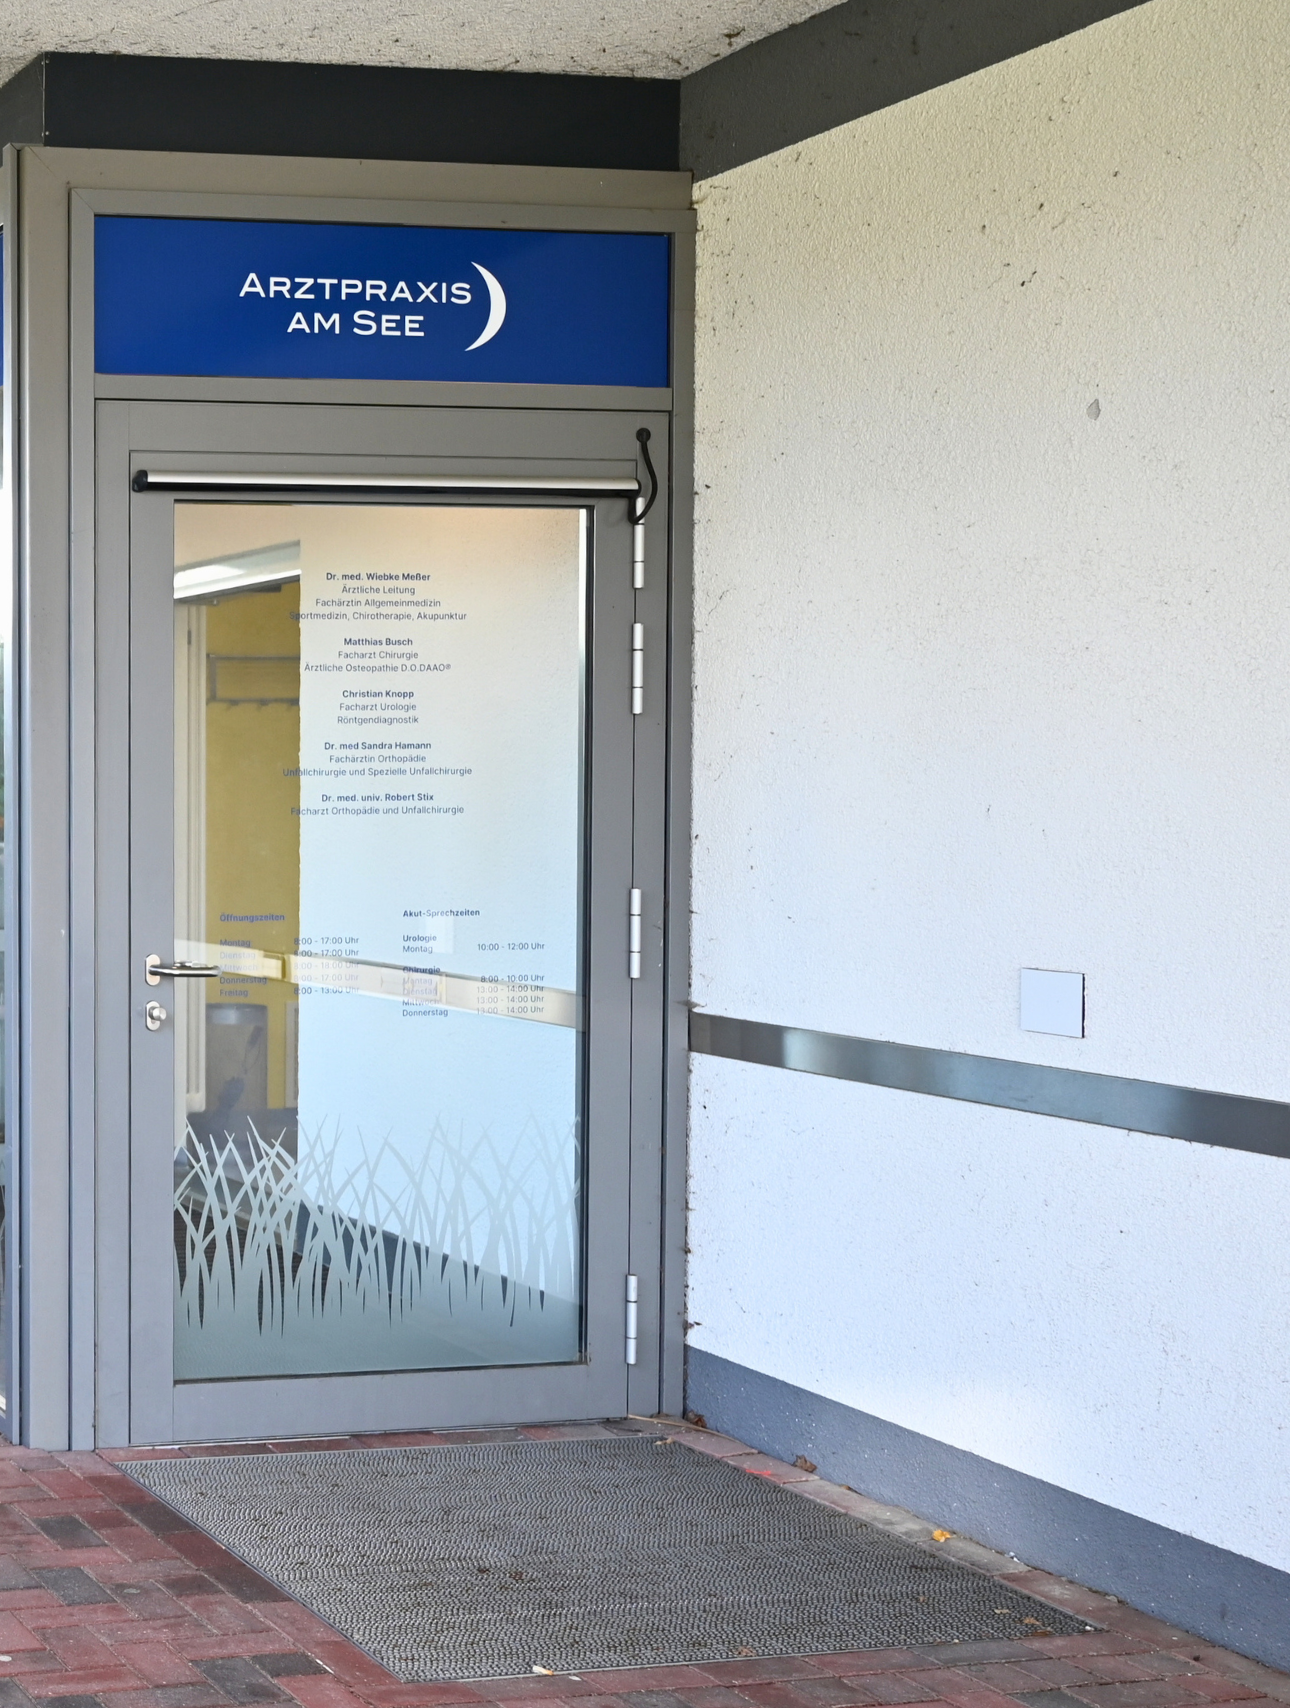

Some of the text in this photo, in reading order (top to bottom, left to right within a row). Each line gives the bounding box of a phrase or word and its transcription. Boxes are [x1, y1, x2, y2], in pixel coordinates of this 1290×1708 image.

[239, 272, 472, 305] ARZTPRAXIS
[287, 310, 424, 337] AM SEE
[326, 572, 430, 581] Dr. med. Wiebke Meßer
[342, 584, 415, 596] Ärztliche Leitung
[315, 598, 441, 609] Fachärztin Allgemeinmedizin
[289, 611, 467, 621] Sportmedizin, Chirotherapie, Akupunktur
[344, 637, 413, 646] Matthias Busch
[338, 650, 418, 661] Facharzt Chirurgie
[304, 662, 343, 672] Ärztliche
[345, 664, 398, 674] Osteopathie
[342, 690, 414, 700] Christian Knopp
[340, 703, 416, 712] Facharzt Urologie
[337, 716, 419, 726] Röntgendiagnostik
[324, 742, 432, 750] Dr. med Sandra Hamann
[329, 755, 426, 764] Fachärztin Orthopädie
[282, 767, 472, 778] Unfallchirurgie und Spezielle Unfallchirurgie
[321, 794, 334, 802] Dr.
[336, 794, 359, 802] med.
[361, 794, 383, 802] univ.
[417, 793, 434, 801] Stix
[291, 806, 464, 816] Facharzt Orthopädie und Unfallchirurgie
[220, 913, 285, 923] Öffnungszeiten
[403, 909, 480, 918] Akut-Sprechzeiten
[219, 939, 251, 948] Montag
[320, 937, 342, 945] 17:00
[402, 934, 437, 943] Urologie
[219, 952, 256, 960] Dienstag
[320, 949, 342, 957] 17:00
[402, 945, 433, 954] Montag
[219, 977, 267, 986] Donnerstag
[219, 989, 248, 998] Freitag
[402, 1009, 448, 1017] Donnerstag
